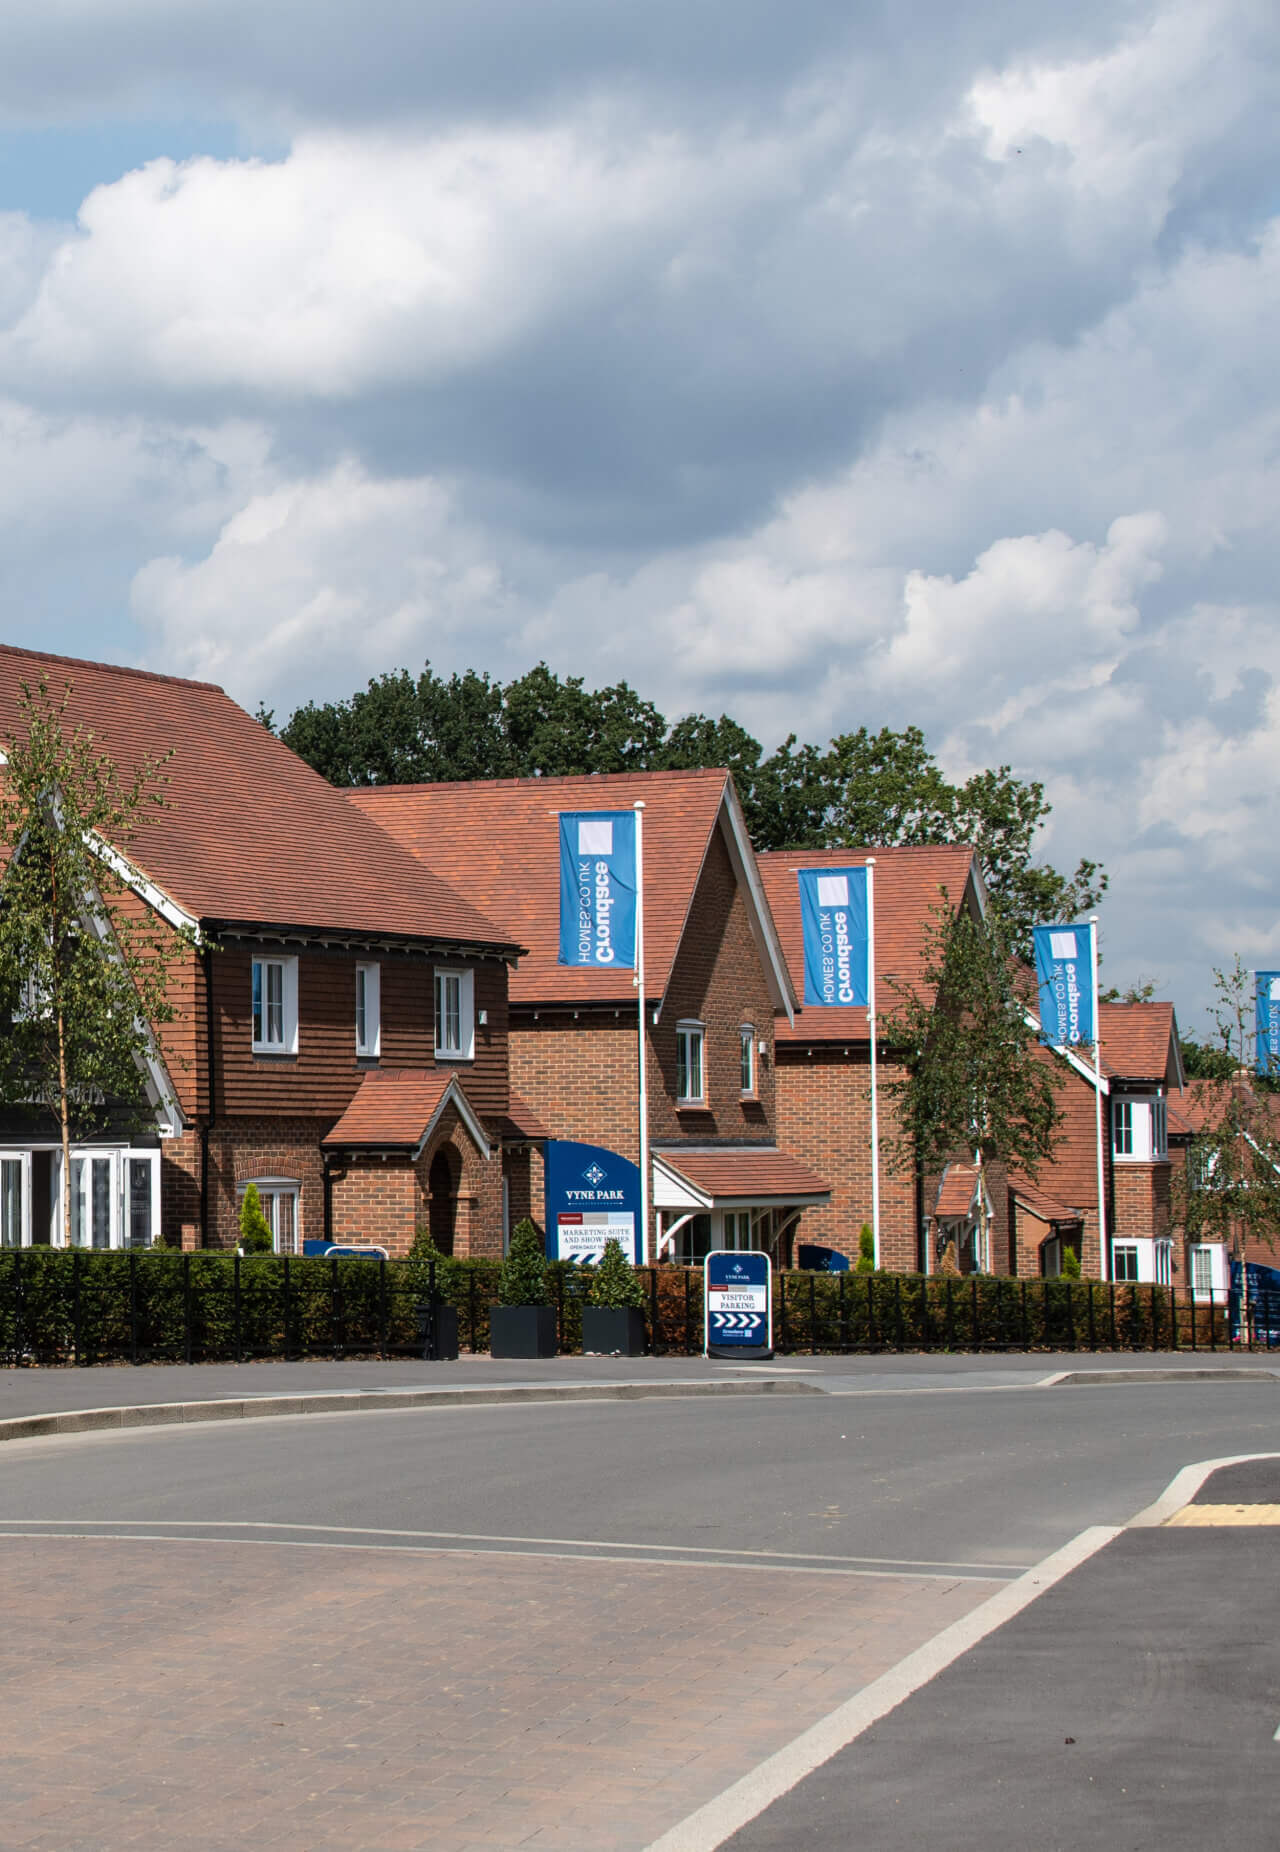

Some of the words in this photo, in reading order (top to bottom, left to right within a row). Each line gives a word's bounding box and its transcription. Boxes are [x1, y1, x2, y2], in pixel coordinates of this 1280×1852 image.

[565, 1190, 595, 1200] VYNE
[596, 1190, 624, 1200] PARK
[721, 1293, 754, 1301] VISITOR
[720, 1302, 755, 1310] PARKING
